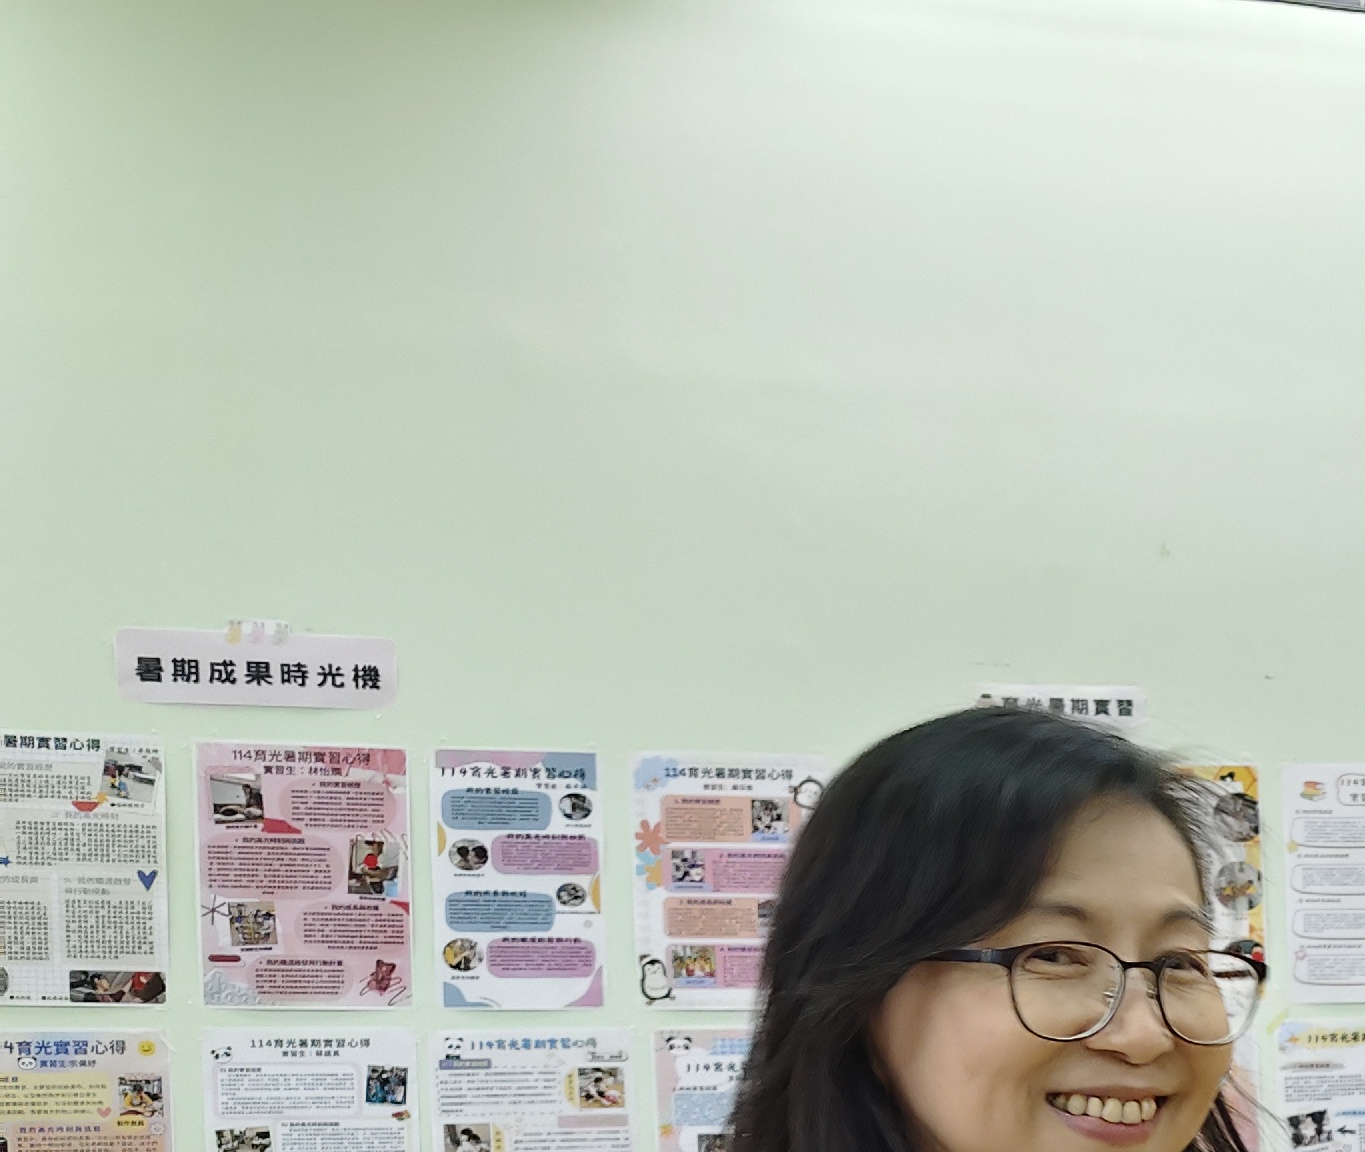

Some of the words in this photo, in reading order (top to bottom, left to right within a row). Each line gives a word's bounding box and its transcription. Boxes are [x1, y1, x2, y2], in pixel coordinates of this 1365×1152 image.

[134, 656, 383, 691] 暑期成果時光機
[0, 734, 102, 752] 暑期實習心得
[231, 748, 371, 766] 114育光暑期實習心得
[0, 1039, 127, 1056] 4育光實習心得
